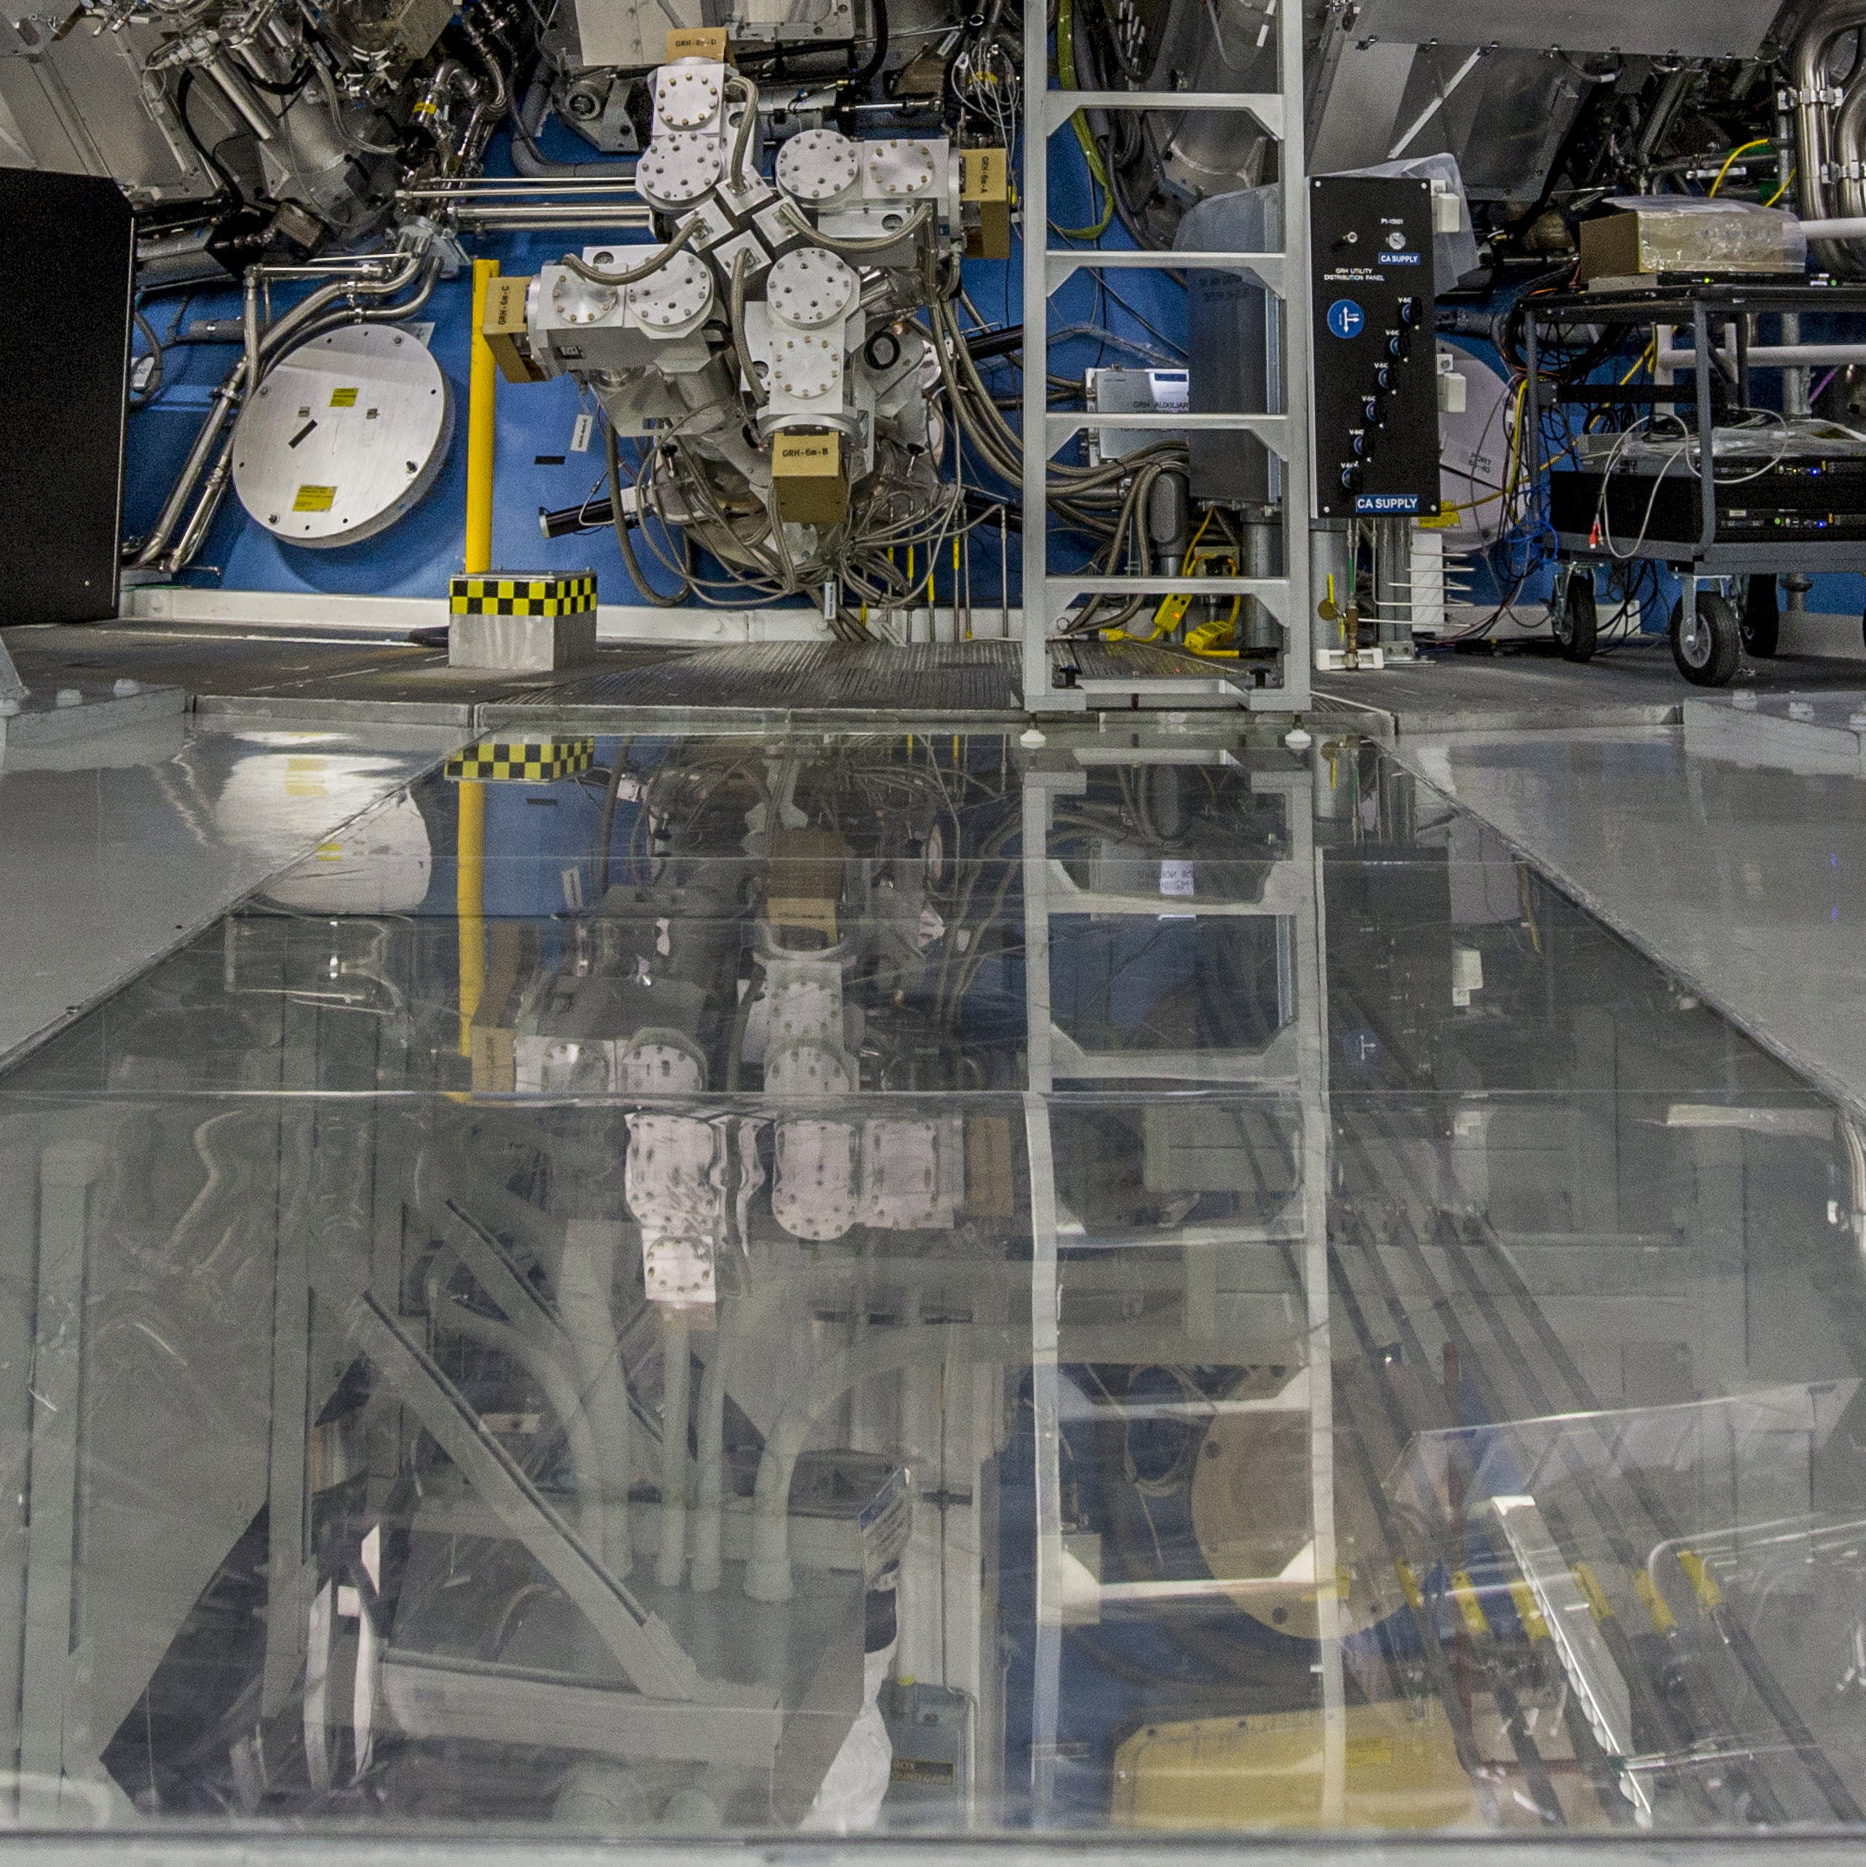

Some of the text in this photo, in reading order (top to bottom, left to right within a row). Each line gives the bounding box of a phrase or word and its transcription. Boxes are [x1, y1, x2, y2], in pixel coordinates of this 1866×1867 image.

[1380, 255, 1419, 264] CA SUPPLY
[1365, 274, 1385, 282] PANEL
[1155, 399, 1190, 411] AUXILIAR
[1357, 497, 1419, 510] CA SUPPLY
